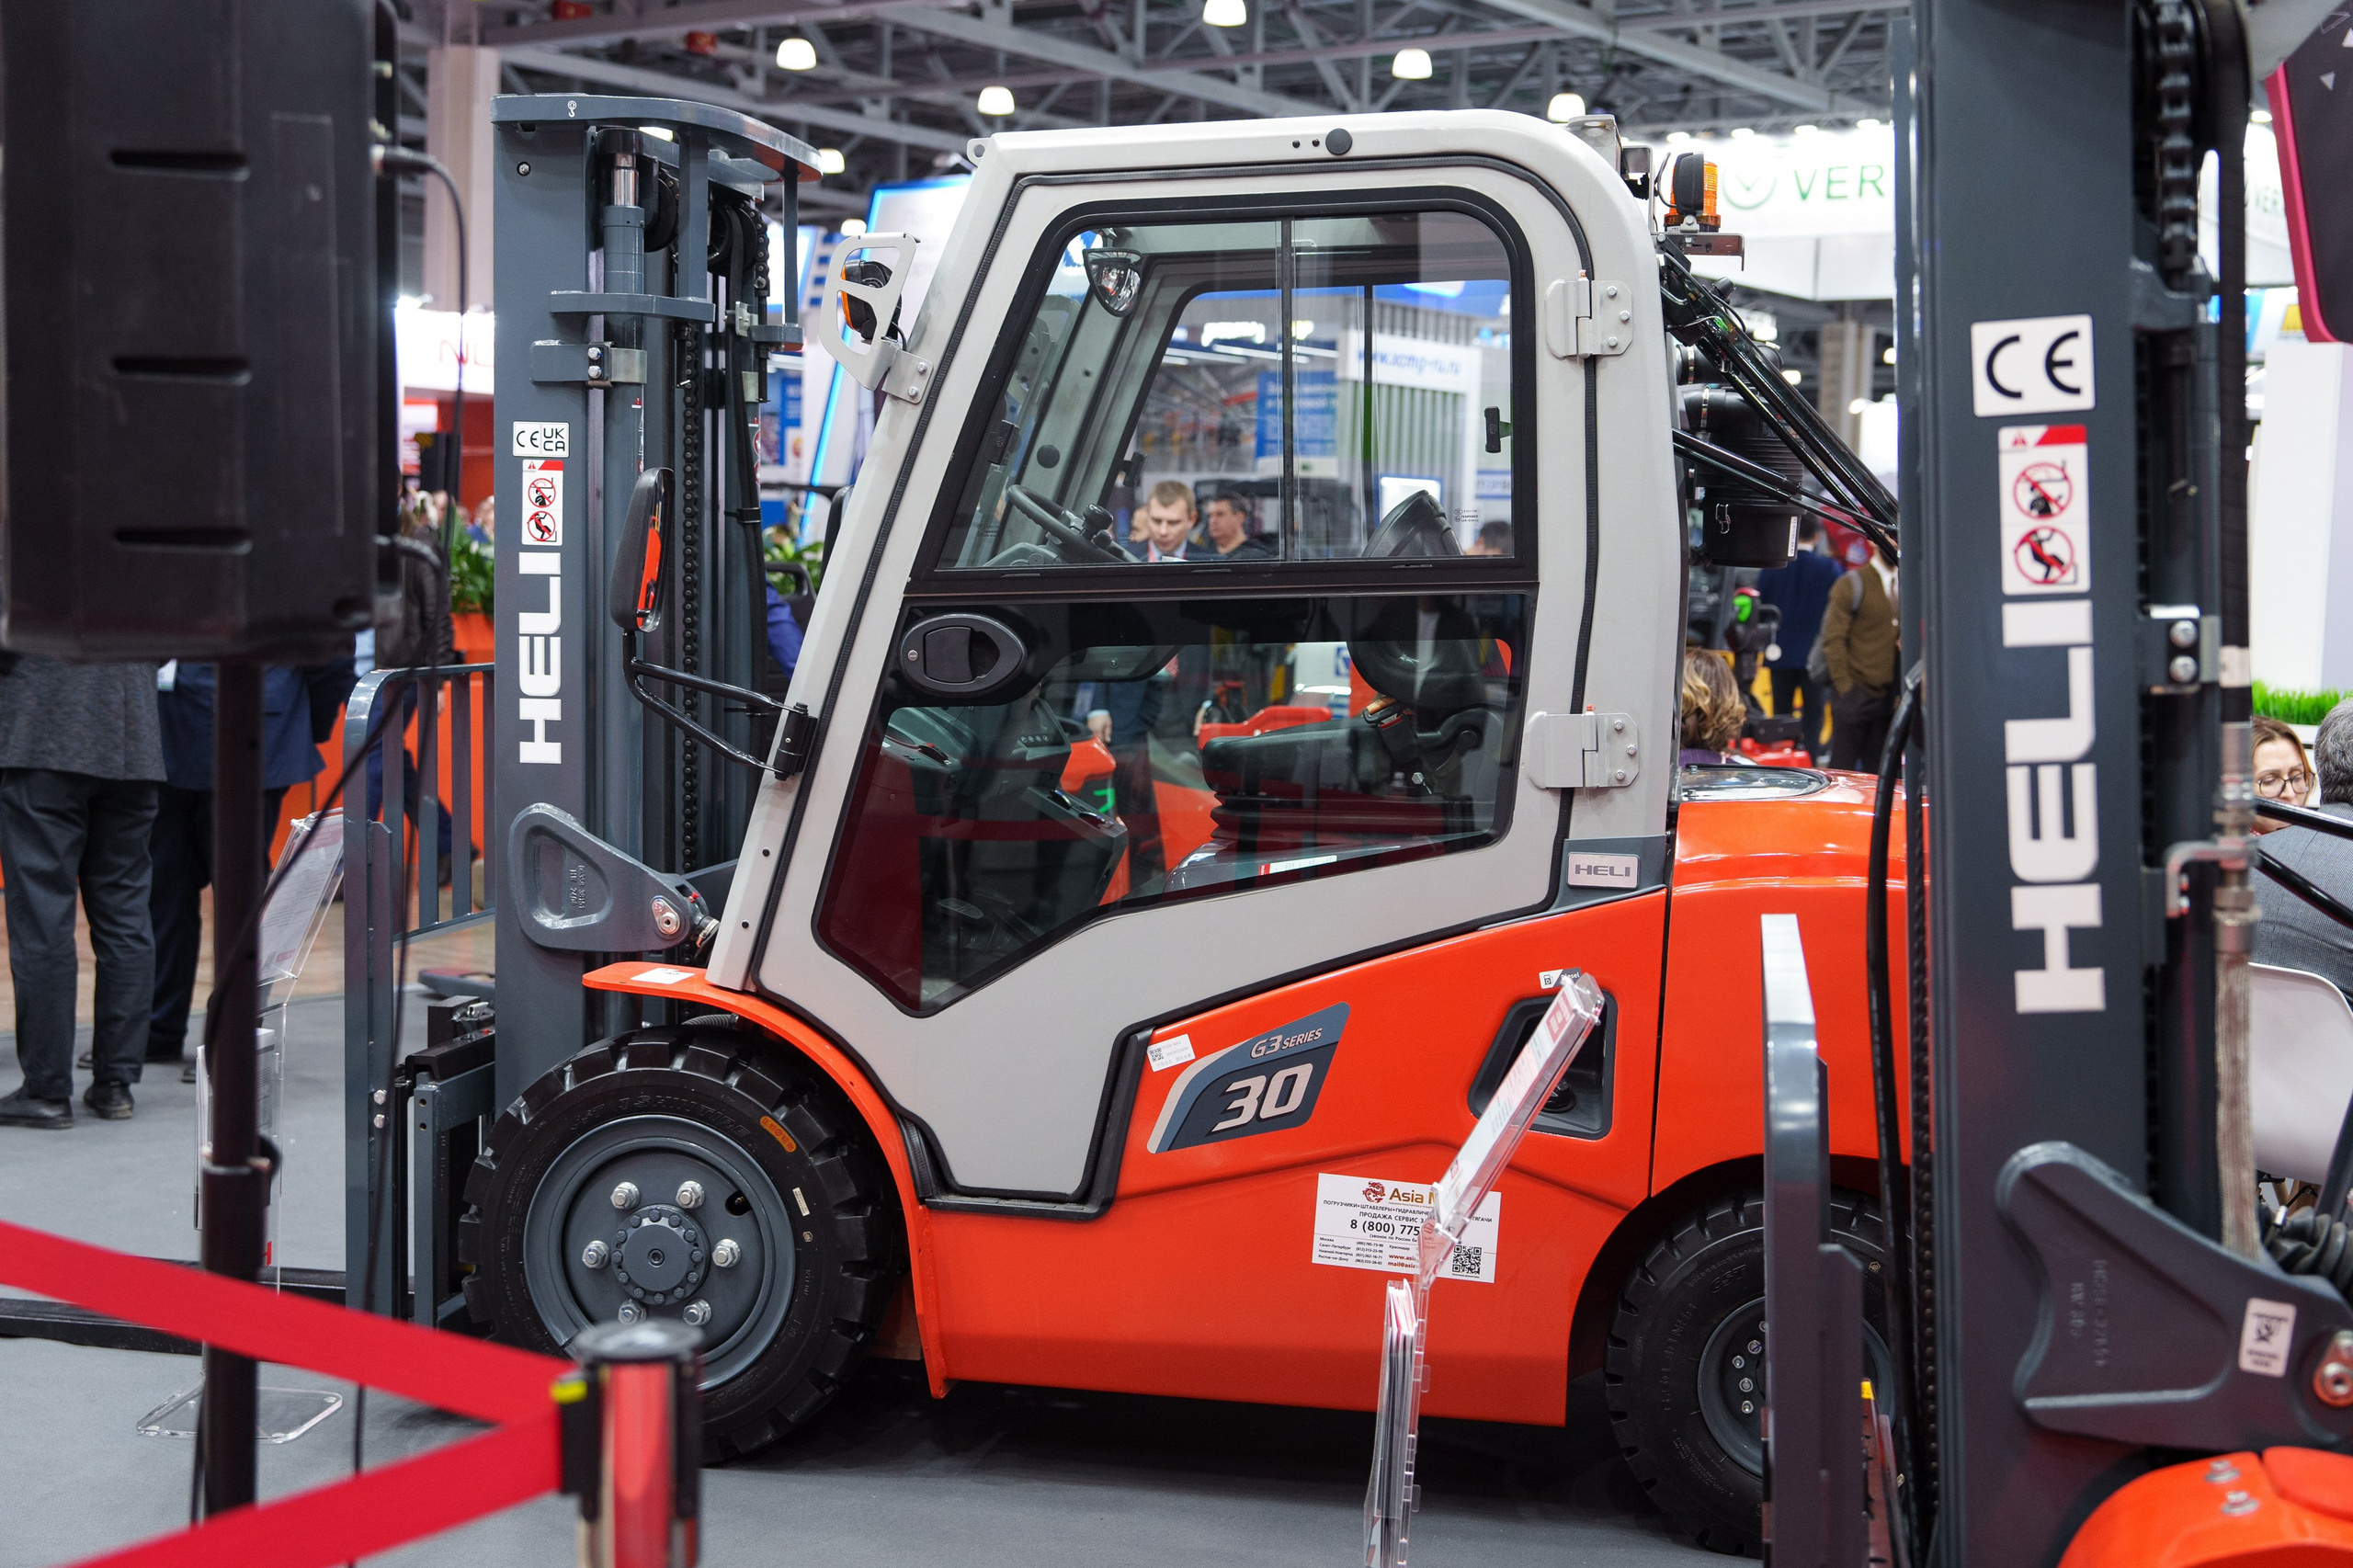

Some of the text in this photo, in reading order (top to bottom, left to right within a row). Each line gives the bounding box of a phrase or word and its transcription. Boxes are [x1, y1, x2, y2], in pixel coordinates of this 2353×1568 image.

[1986, 331, 2081, 399] CE
[517, 430, 540, 448] CE
[543, 427, 565, 439] UK
[543, 441, 565, 451] CA
[519, 552, 562, 765] HELI
[2002, 599, 2107, 1014] HELI
[1574, 864, 1631, 878] HELI
[1250, 1028, 1323, 1059] G3 SERIES
[1205, 1062, 1314, 1133] 30
[1389, 1187, 1424, 1204] Asia
[1359, 1211, 1392, 1221] ПРОДАЖА
[1394, 1215, 1418, 1223] СЕРВИС
[1395, 1208, 1431, 1216] ГИДРАВЛИЧЕ
[1350, 1220, 1358, 1229] 8
[1362, 1220, 1395, 1236] (800)
